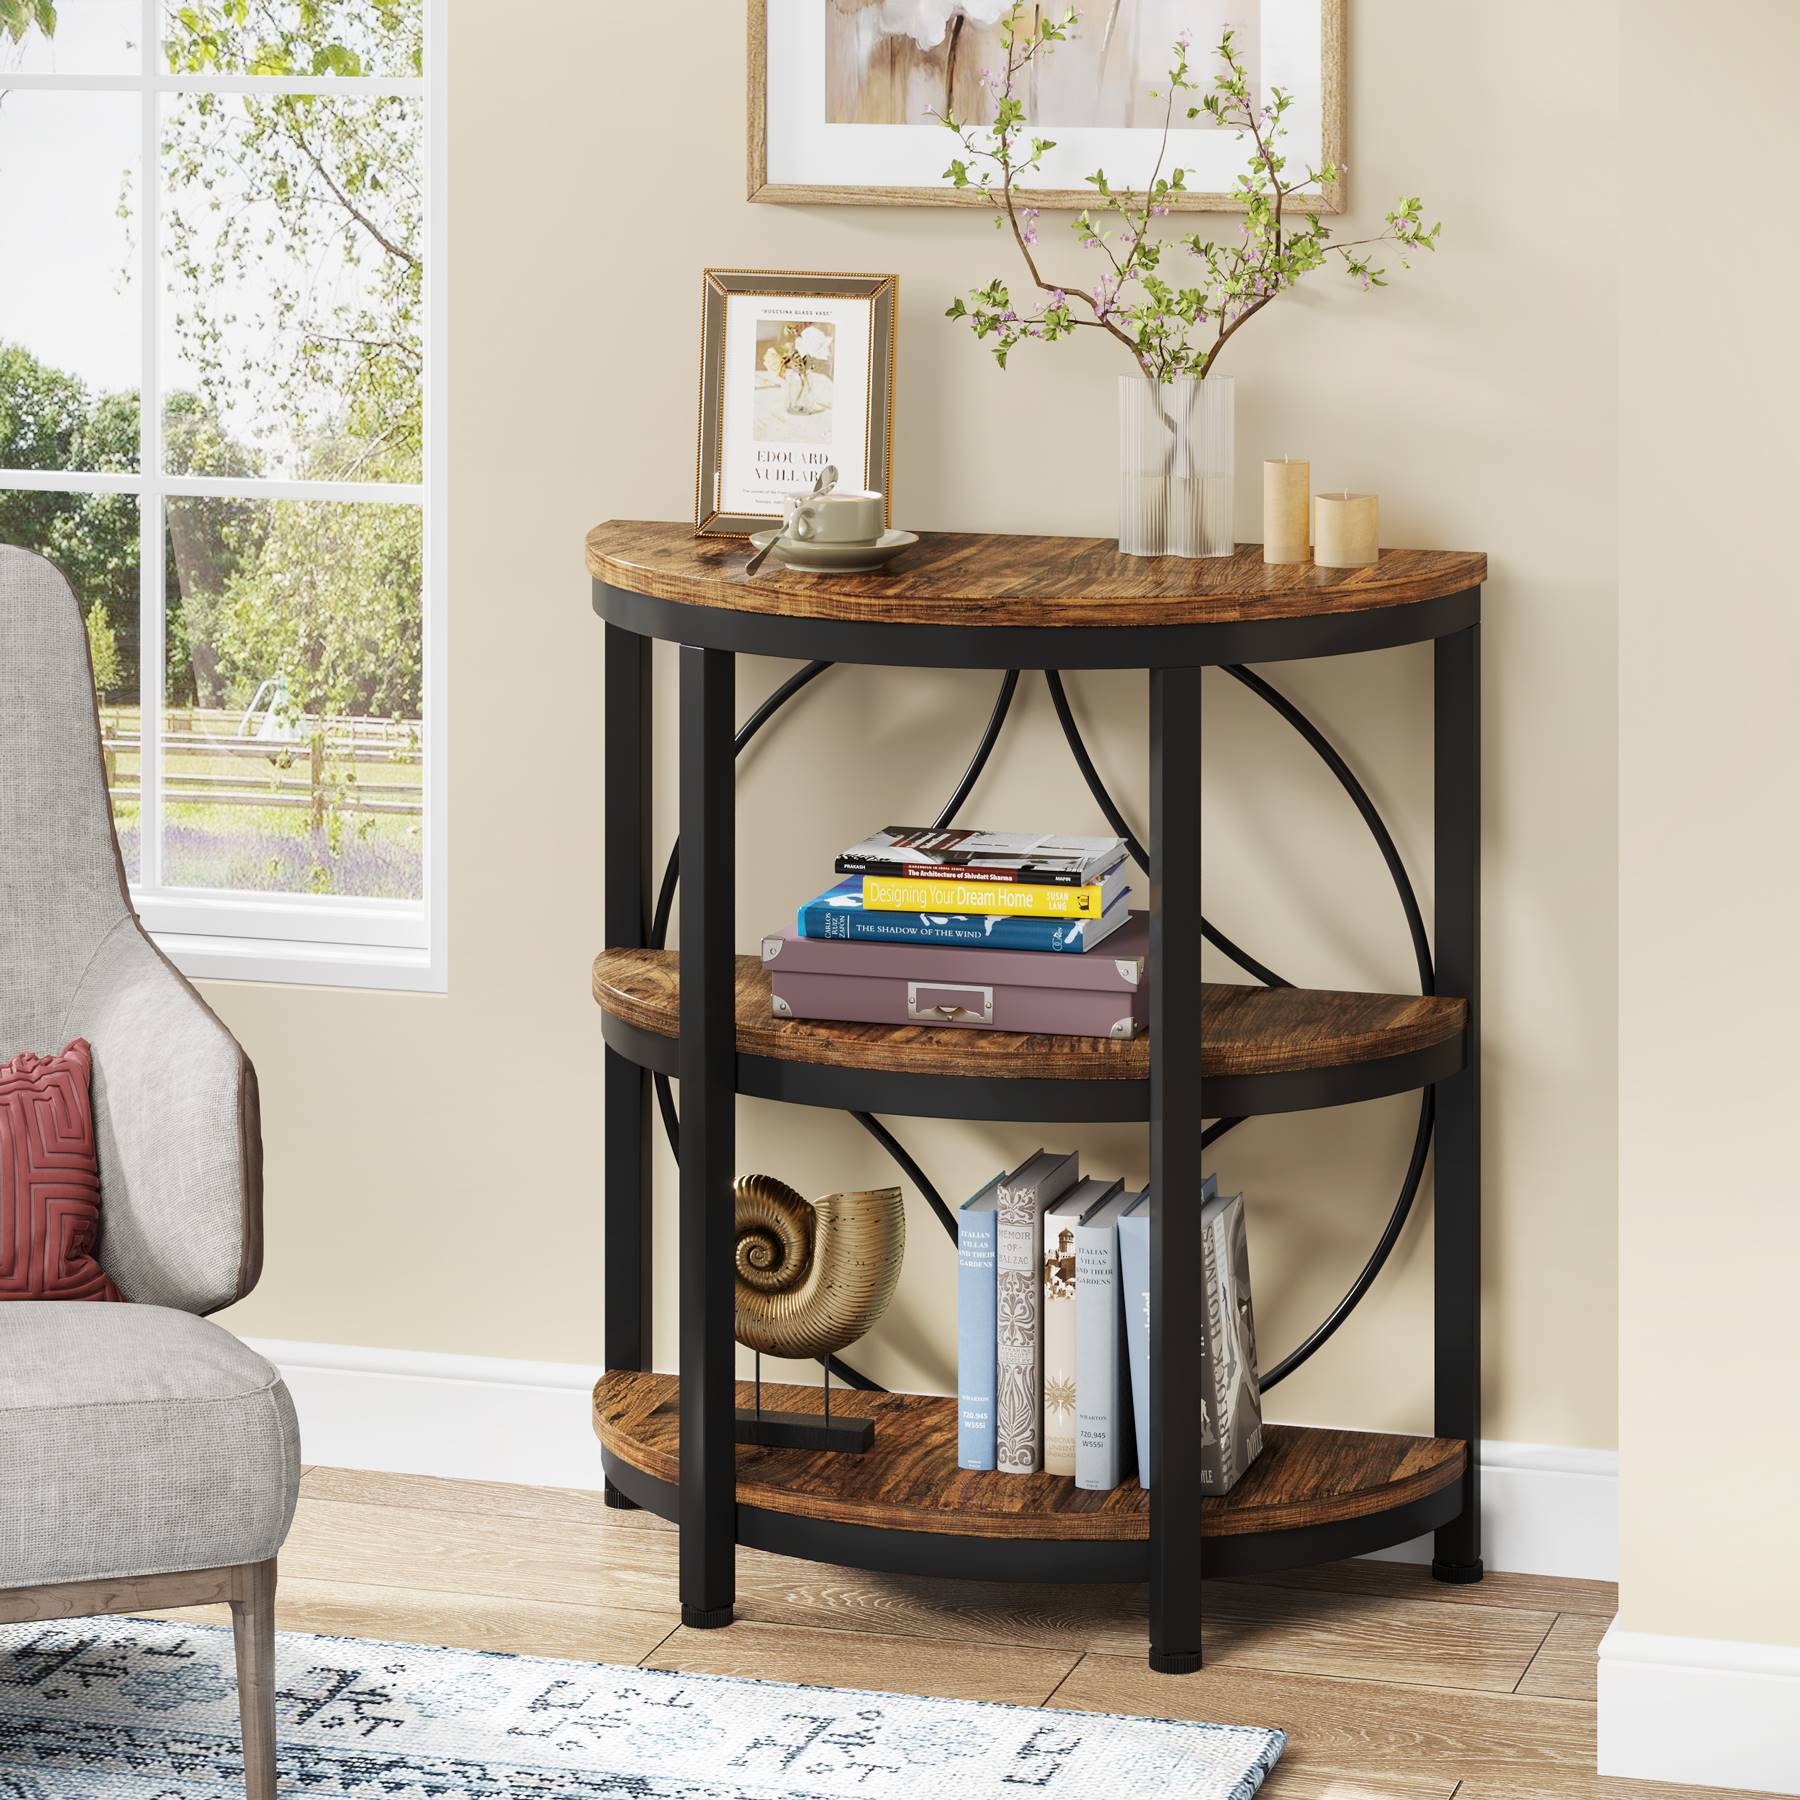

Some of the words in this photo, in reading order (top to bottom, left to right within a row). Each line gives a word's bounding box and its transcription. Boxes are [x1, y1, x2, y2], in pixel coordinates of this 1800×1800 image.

[757, 450, 829, 465] EDOUARD
[755, 467, 819, 482] VUILLAR
[844, 863, 866, 871] PRAKASH
[908, 869, 920, 877] The
[920, 870, 956, 879] Architecture
[964, 872, 989, 880] Shivdatt
[870, 882, 927, 908] Designing
[929, 886, 954, 904] Your
[957, 886, 995, 906] Dream
[998, 887, 1033, 908] Home
[1047, 891, 1069, 901] SUSAN
[1048, 901, 1067, 911] LANG
[824, 912, 832, 939] CARLOS
[856, 924, 875, 933] THE
[877, 925, 918, 935] SHADOW
[920, 928, 933, 936] OF
[935, 929, 955, 938] THE
[955, 930, 982, 939] WIND
[961, 1230, 991, 1239] ITALIAN
[963, 1240, 989, 1249] VILLAS
[1078, 1247, 1108, 1256] ITALIAN
[960, 1259, 993, 1269] GARDENS
[1080, 1257, 1107, 1265] VILLAS
[1077, 1277, 1111, 1285] GARDENS
[1200, 1224, 1220, 1338] HOLMES
[963, 1411, 989, 1420] 720.945
[1080, 1430, 1106, 1439] 720.945
